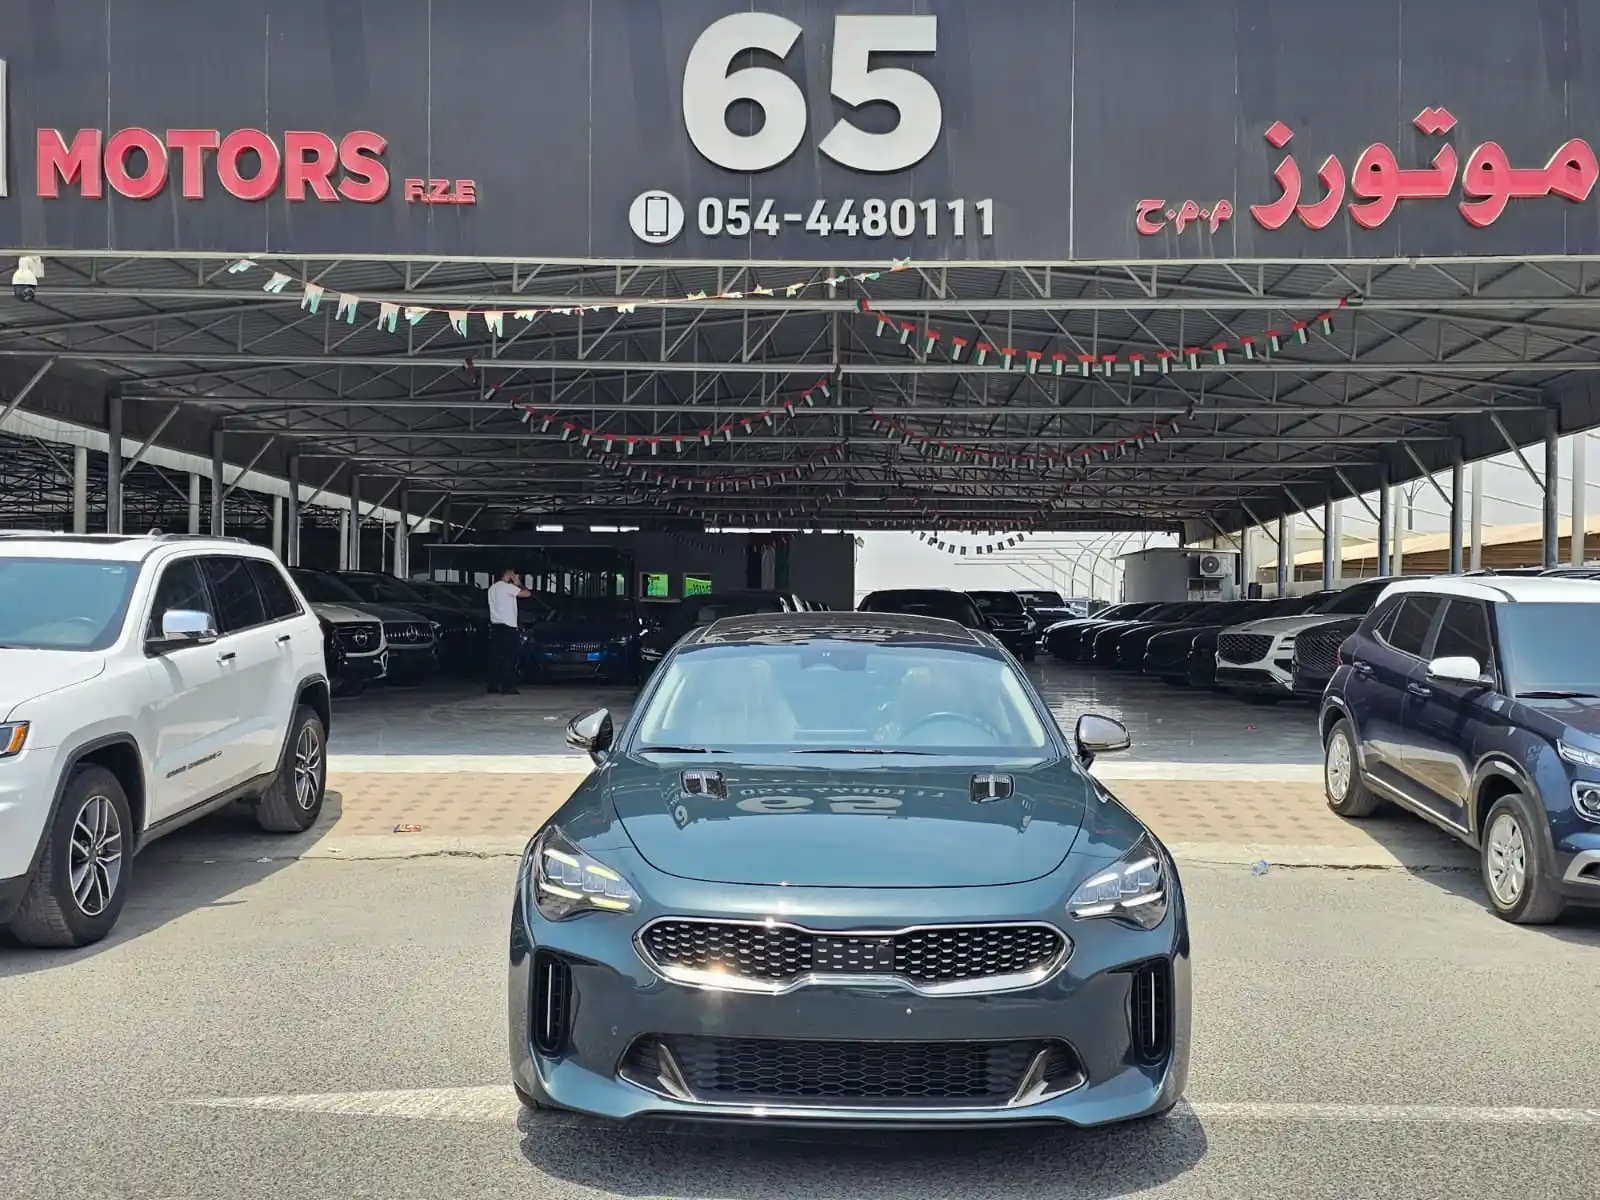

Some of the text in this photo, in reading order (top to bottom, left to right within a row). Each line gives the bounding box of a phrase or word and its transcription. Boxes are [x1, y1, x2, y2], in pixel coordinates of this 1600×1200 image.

[682, 12, 942, 172] 65
[37, 127, 390, 204] MOTORS
[1250, 106, 1600, 230] موتورز
[698, 197, 993, 237] 054-4480111
